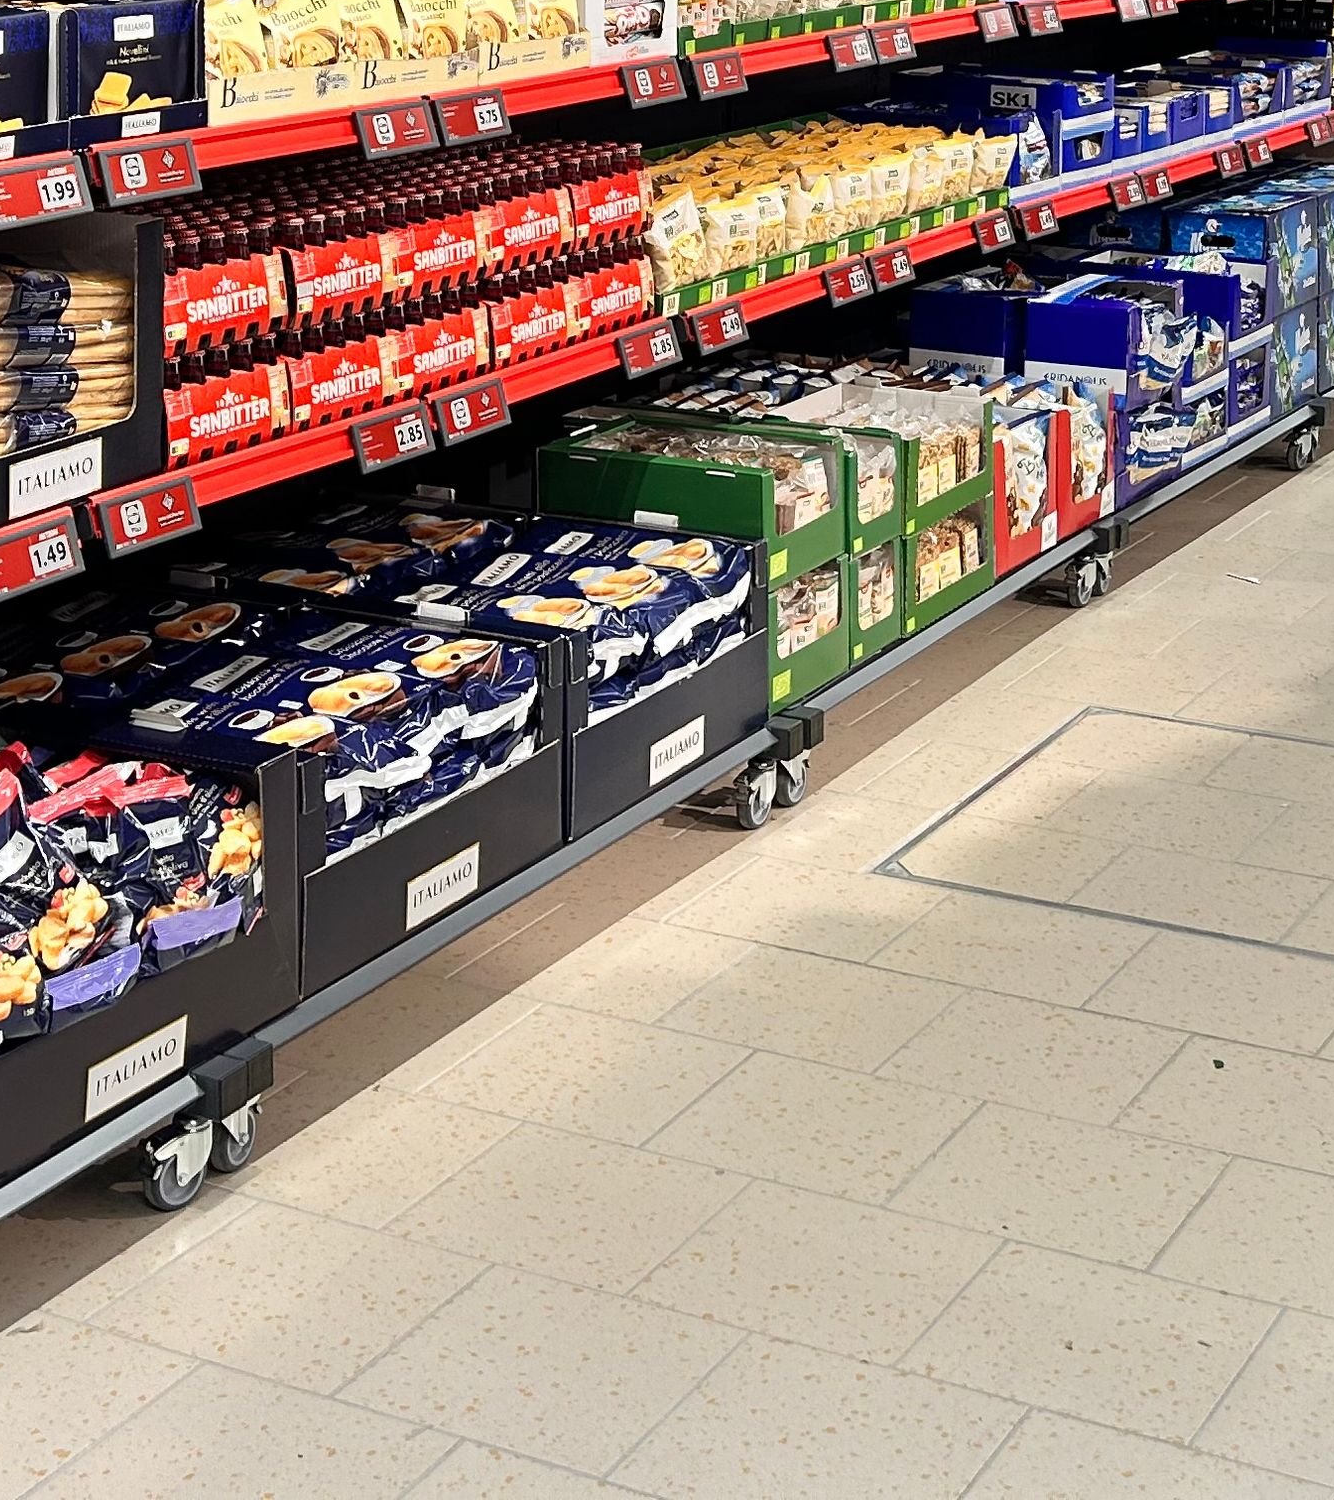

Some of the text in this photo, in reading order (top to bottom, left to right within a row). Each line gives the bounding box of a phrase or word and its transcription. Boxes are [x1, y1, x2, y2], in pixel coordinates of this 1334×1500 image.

[992, 92, 1031, 108] SK1
[478, 109, 498, 125] 5.75
[42, 179, 76, 203] 1.99
[721, 315, 741, 335] 2.49
[651, 337, 673, 357] 2.85
[397, 424, 423, 448] 2.85
[17, 455, 94, 496] ITALIAMO
[33, 543, 68, 568] 1.49
[653, 730, 701, 769] ITALIAMO
[412, 858, 475, 911] ITALIAMO
[95, 1035, 179, 1099] ITALIAMO
